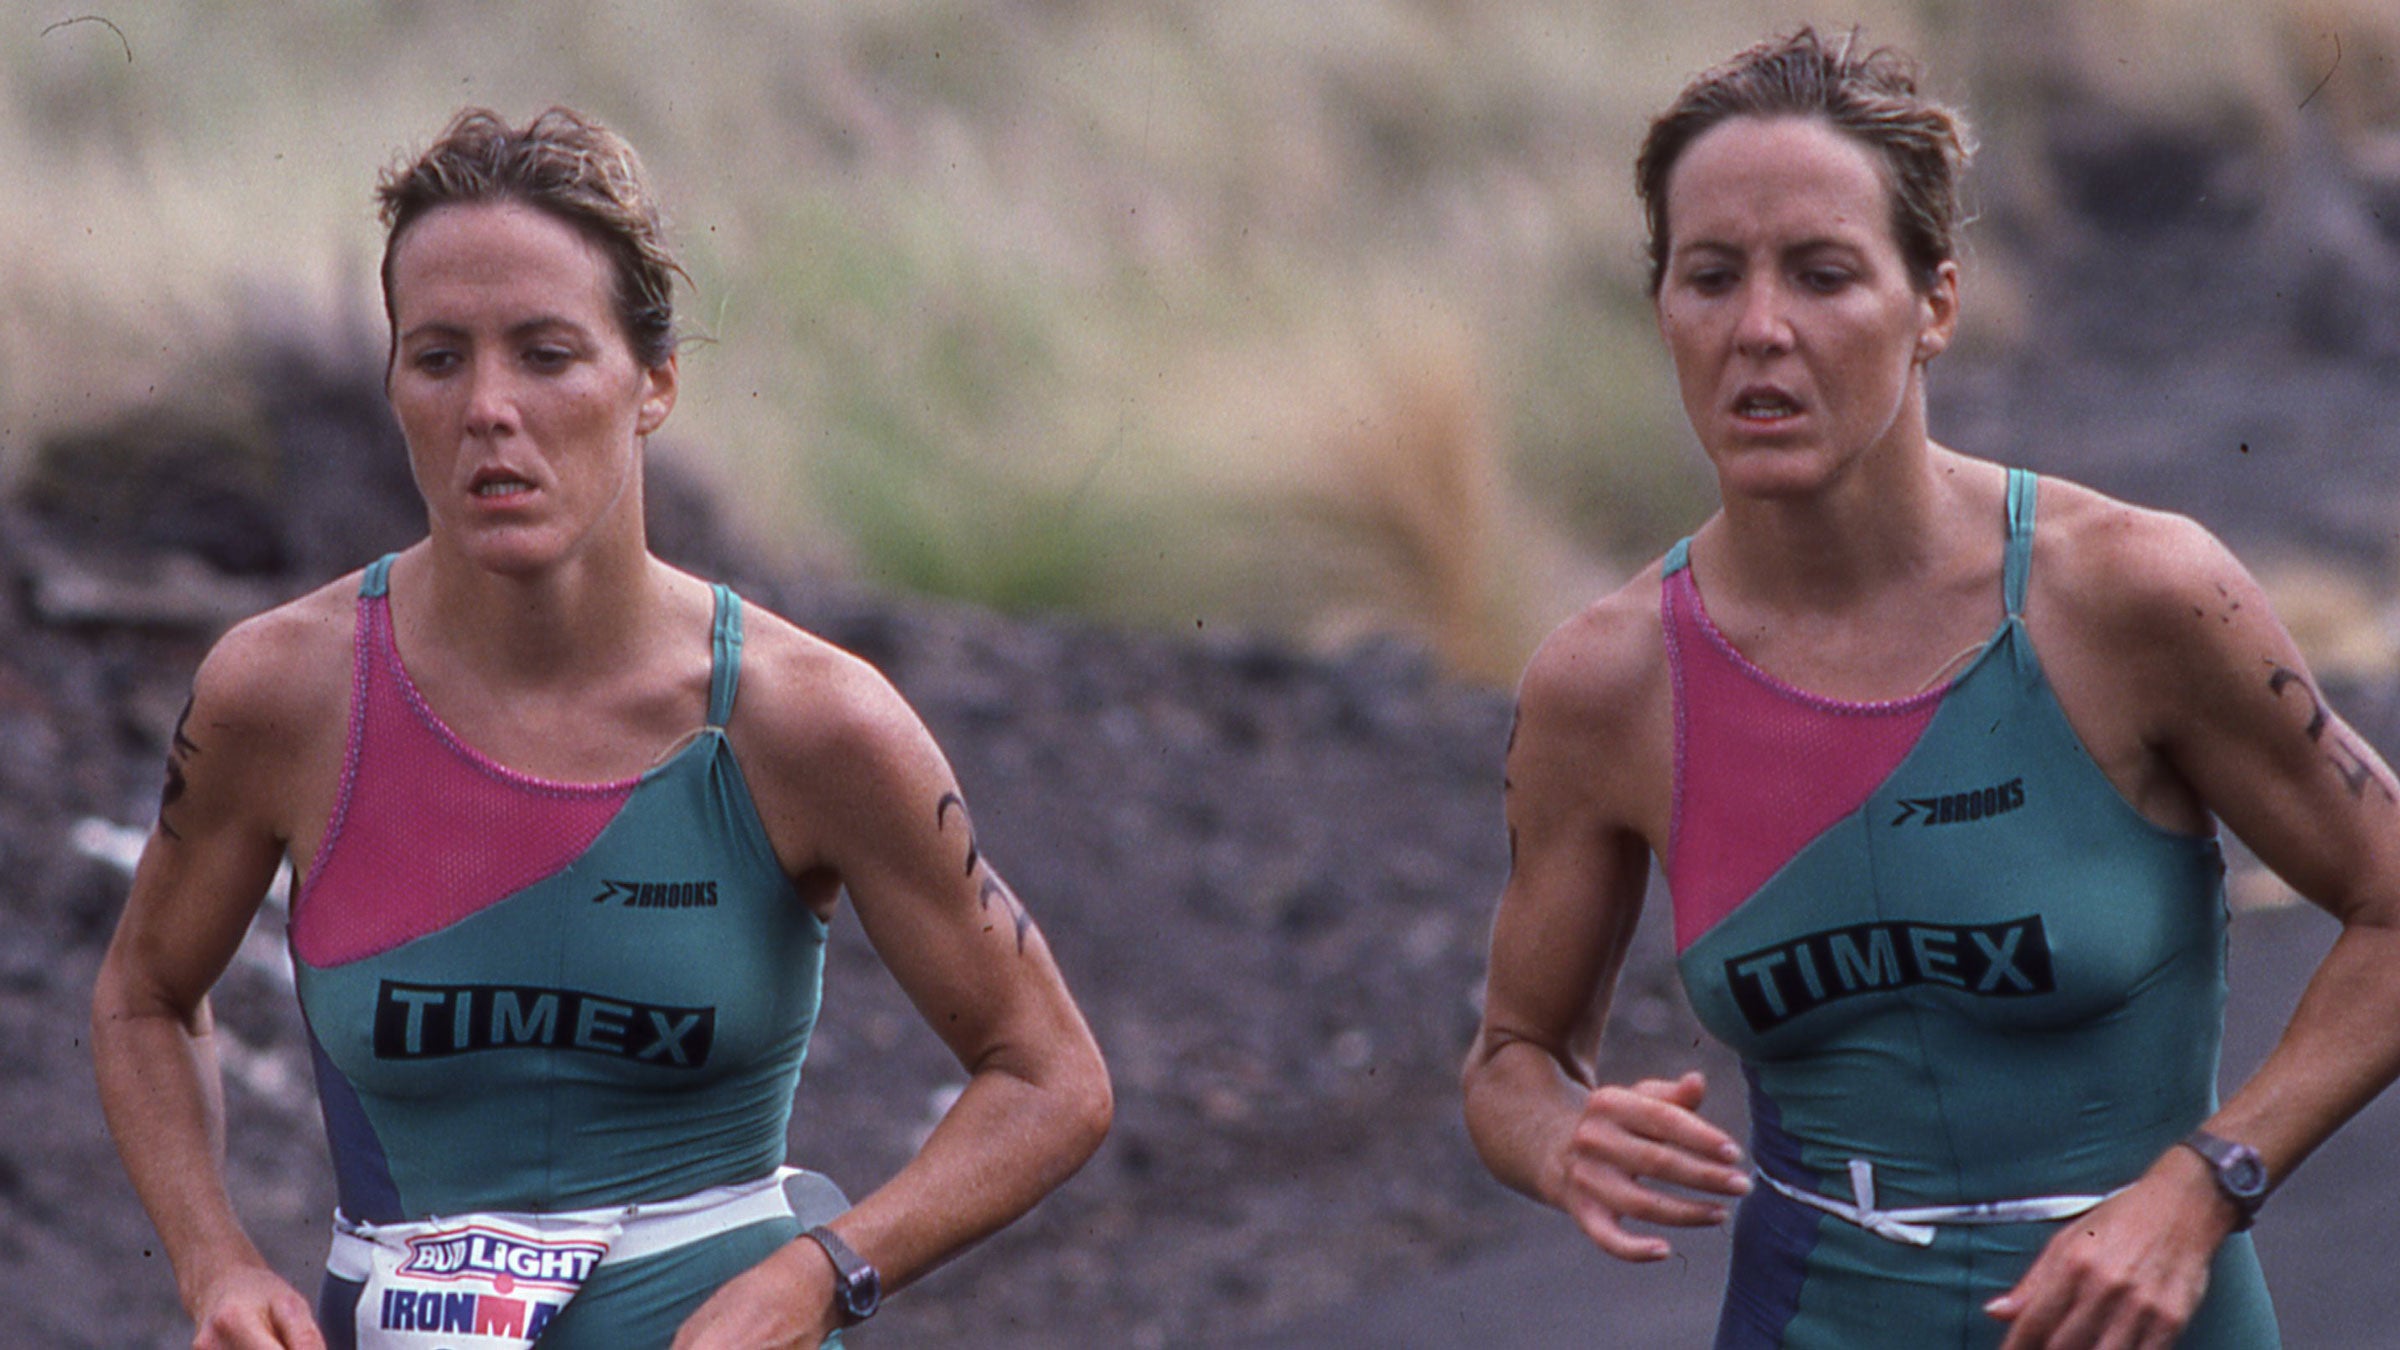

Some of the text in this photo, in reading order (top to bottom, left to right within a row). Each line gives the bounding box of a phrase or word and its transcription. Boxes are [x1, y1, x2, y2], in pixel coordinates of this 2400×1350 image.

[1938, 778, 2024, 825] BROOKS
[638, 881, 718, 908] BROOKS
[1738, 926, 2036, 1017] TIMEX
[391, 989, 700, 1064] TIMEX
[412, 1241, 467, 1271] BUD
